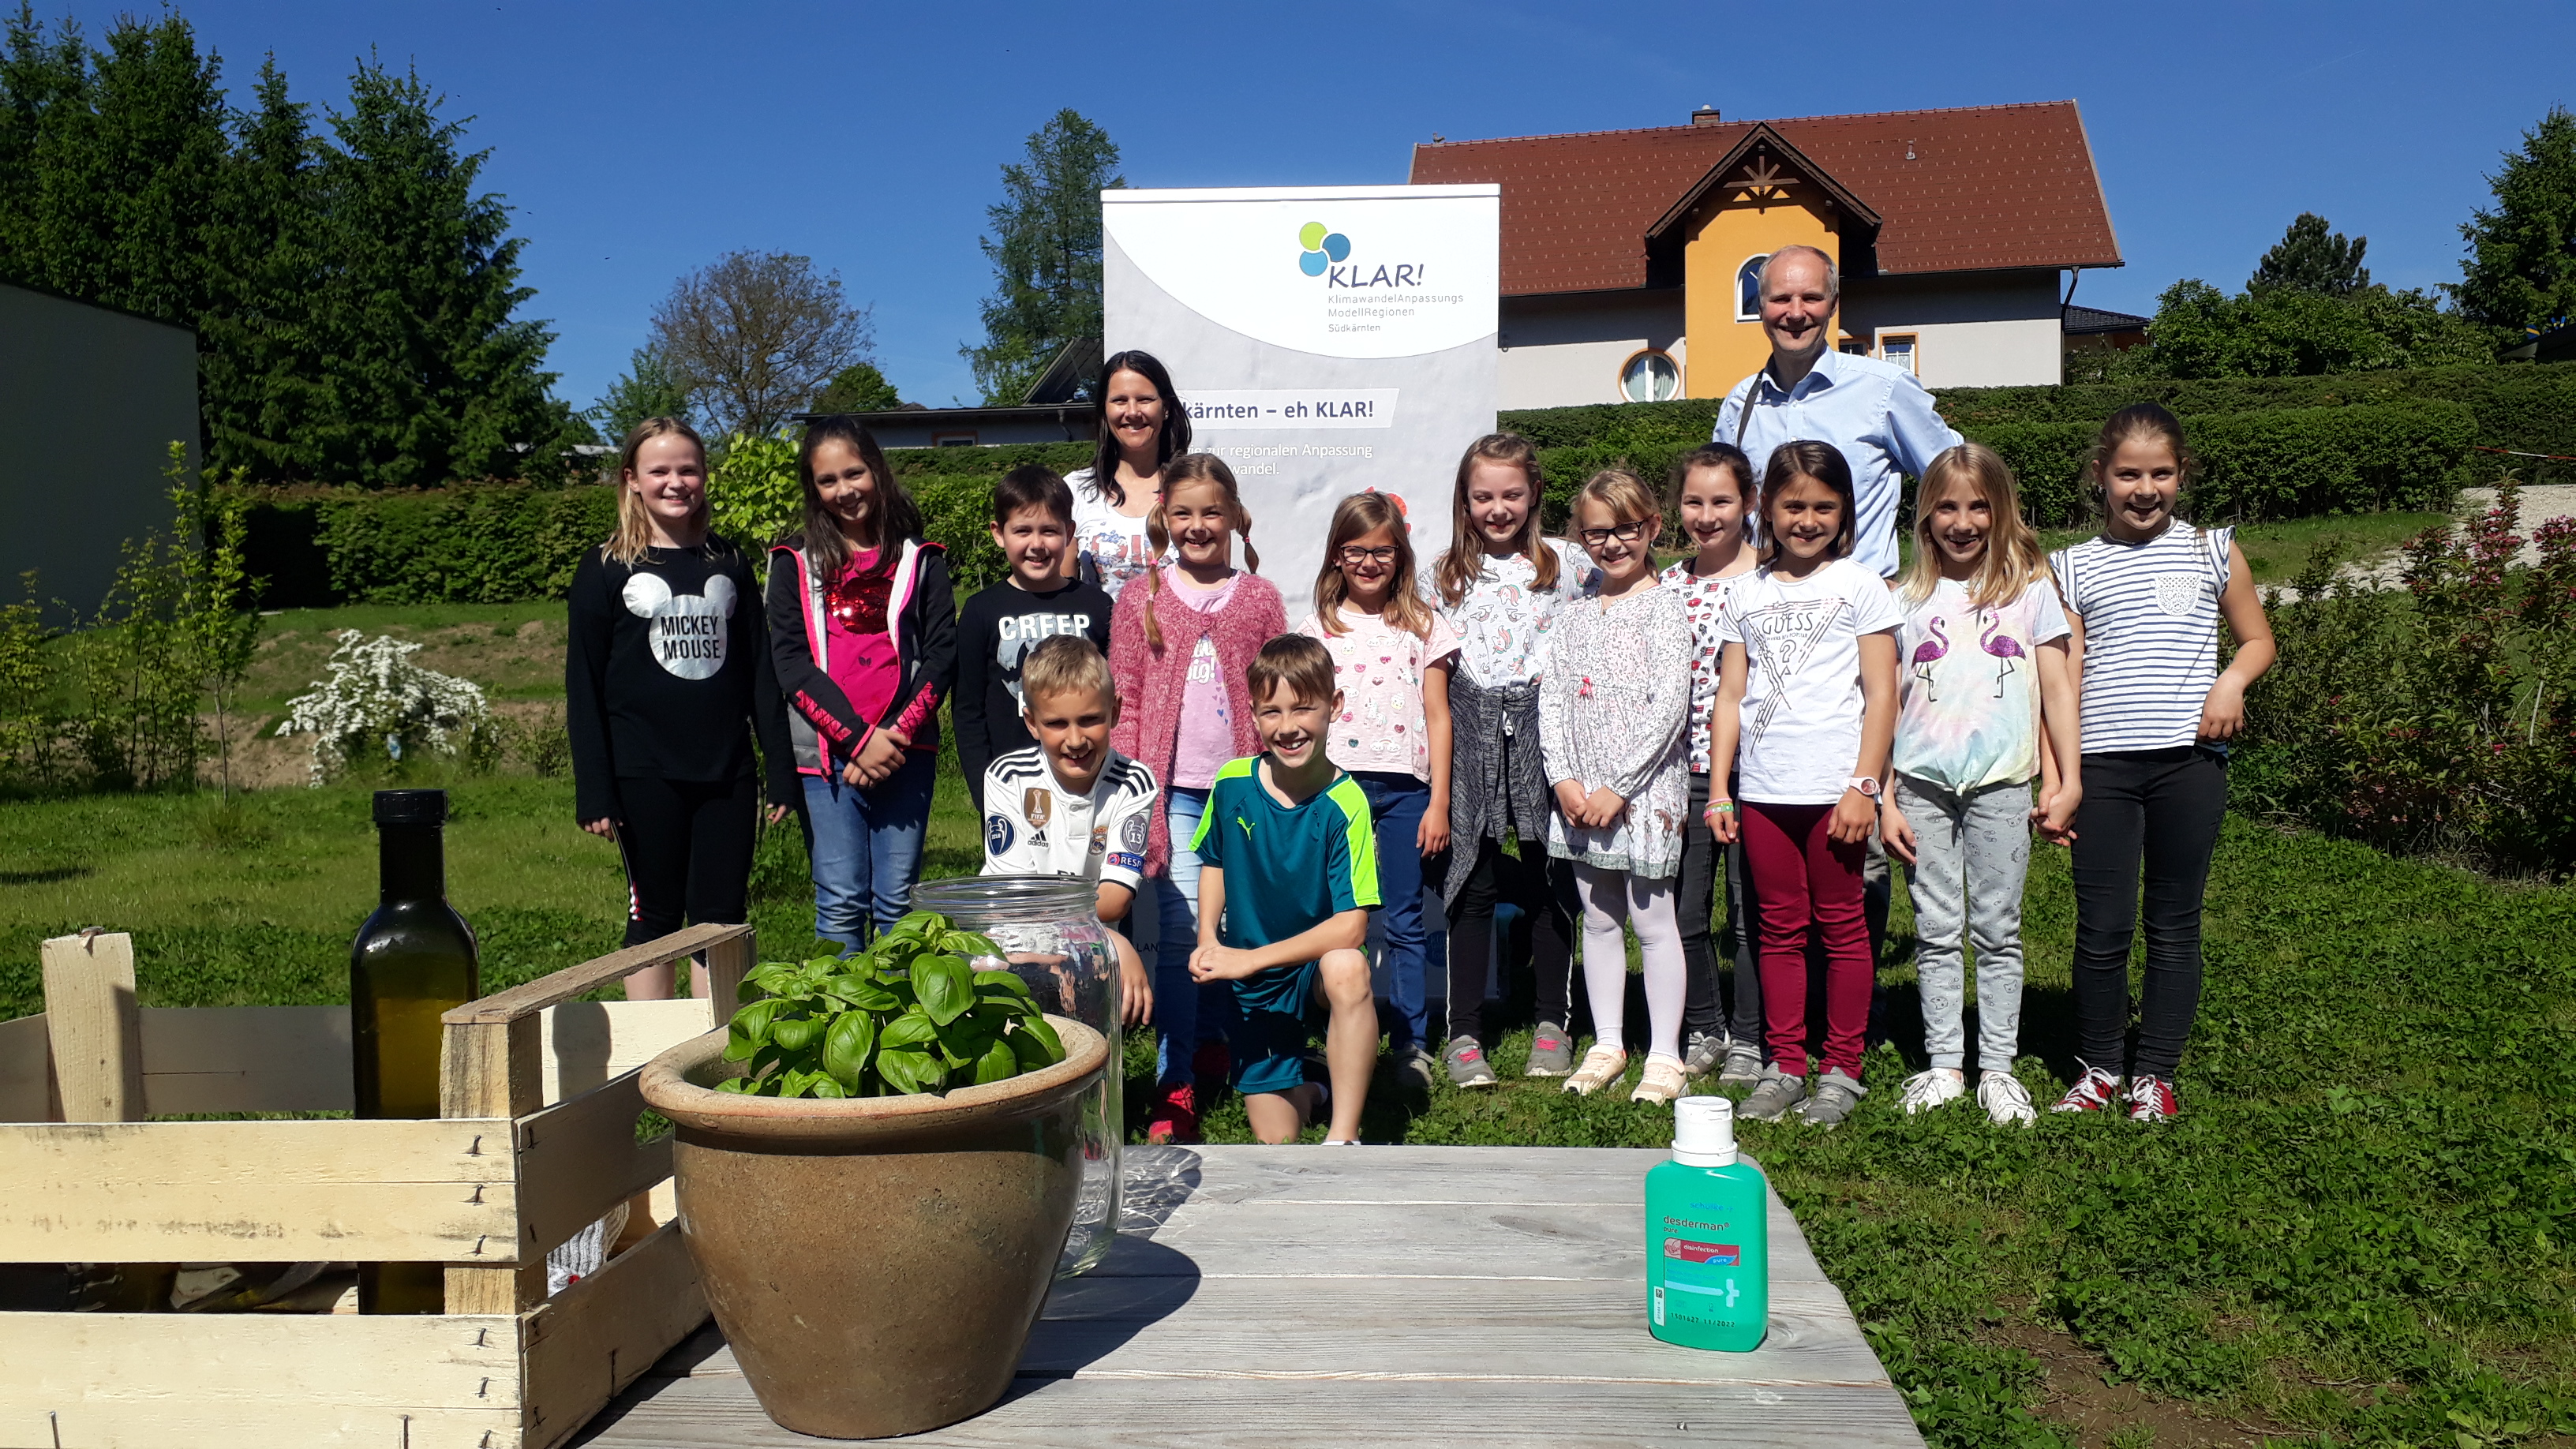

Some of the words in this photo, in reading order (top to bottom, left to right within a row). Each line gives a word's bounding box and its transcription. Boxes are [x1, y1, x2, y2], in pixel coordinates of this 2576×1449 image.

[1328, 264, 1424, 289] KLAR!
[1328, 294, 1464, 305] KlimawandelAnpassungs
[1328, 307, 1415, 318] ModellRegionen
[1328, 324, 1381, 332] Südkärnten
[1284, 401, 1308, 418] eh
[1316, 400, 1374, 417] KLAR!
[1207, 447, 1226, 456] zur
[1230, 444, 1298, 459] regionalen
[1301, 444, 1373, 459] Anpassung
[661, 616, 719, 637] MICKEY
[998, 614, 1090, 641] CREEP
[1762, 612, 1814, 635] GUESS
[663, 639, 721, 660] MOUSE
[1027, 840, 1049, 848] adidas
[1130, 832, 1142, 845] 13
[1683, 1244, 1719, 1253] disinfection
[1704, 1319, 1735, 1327] 11/2022
